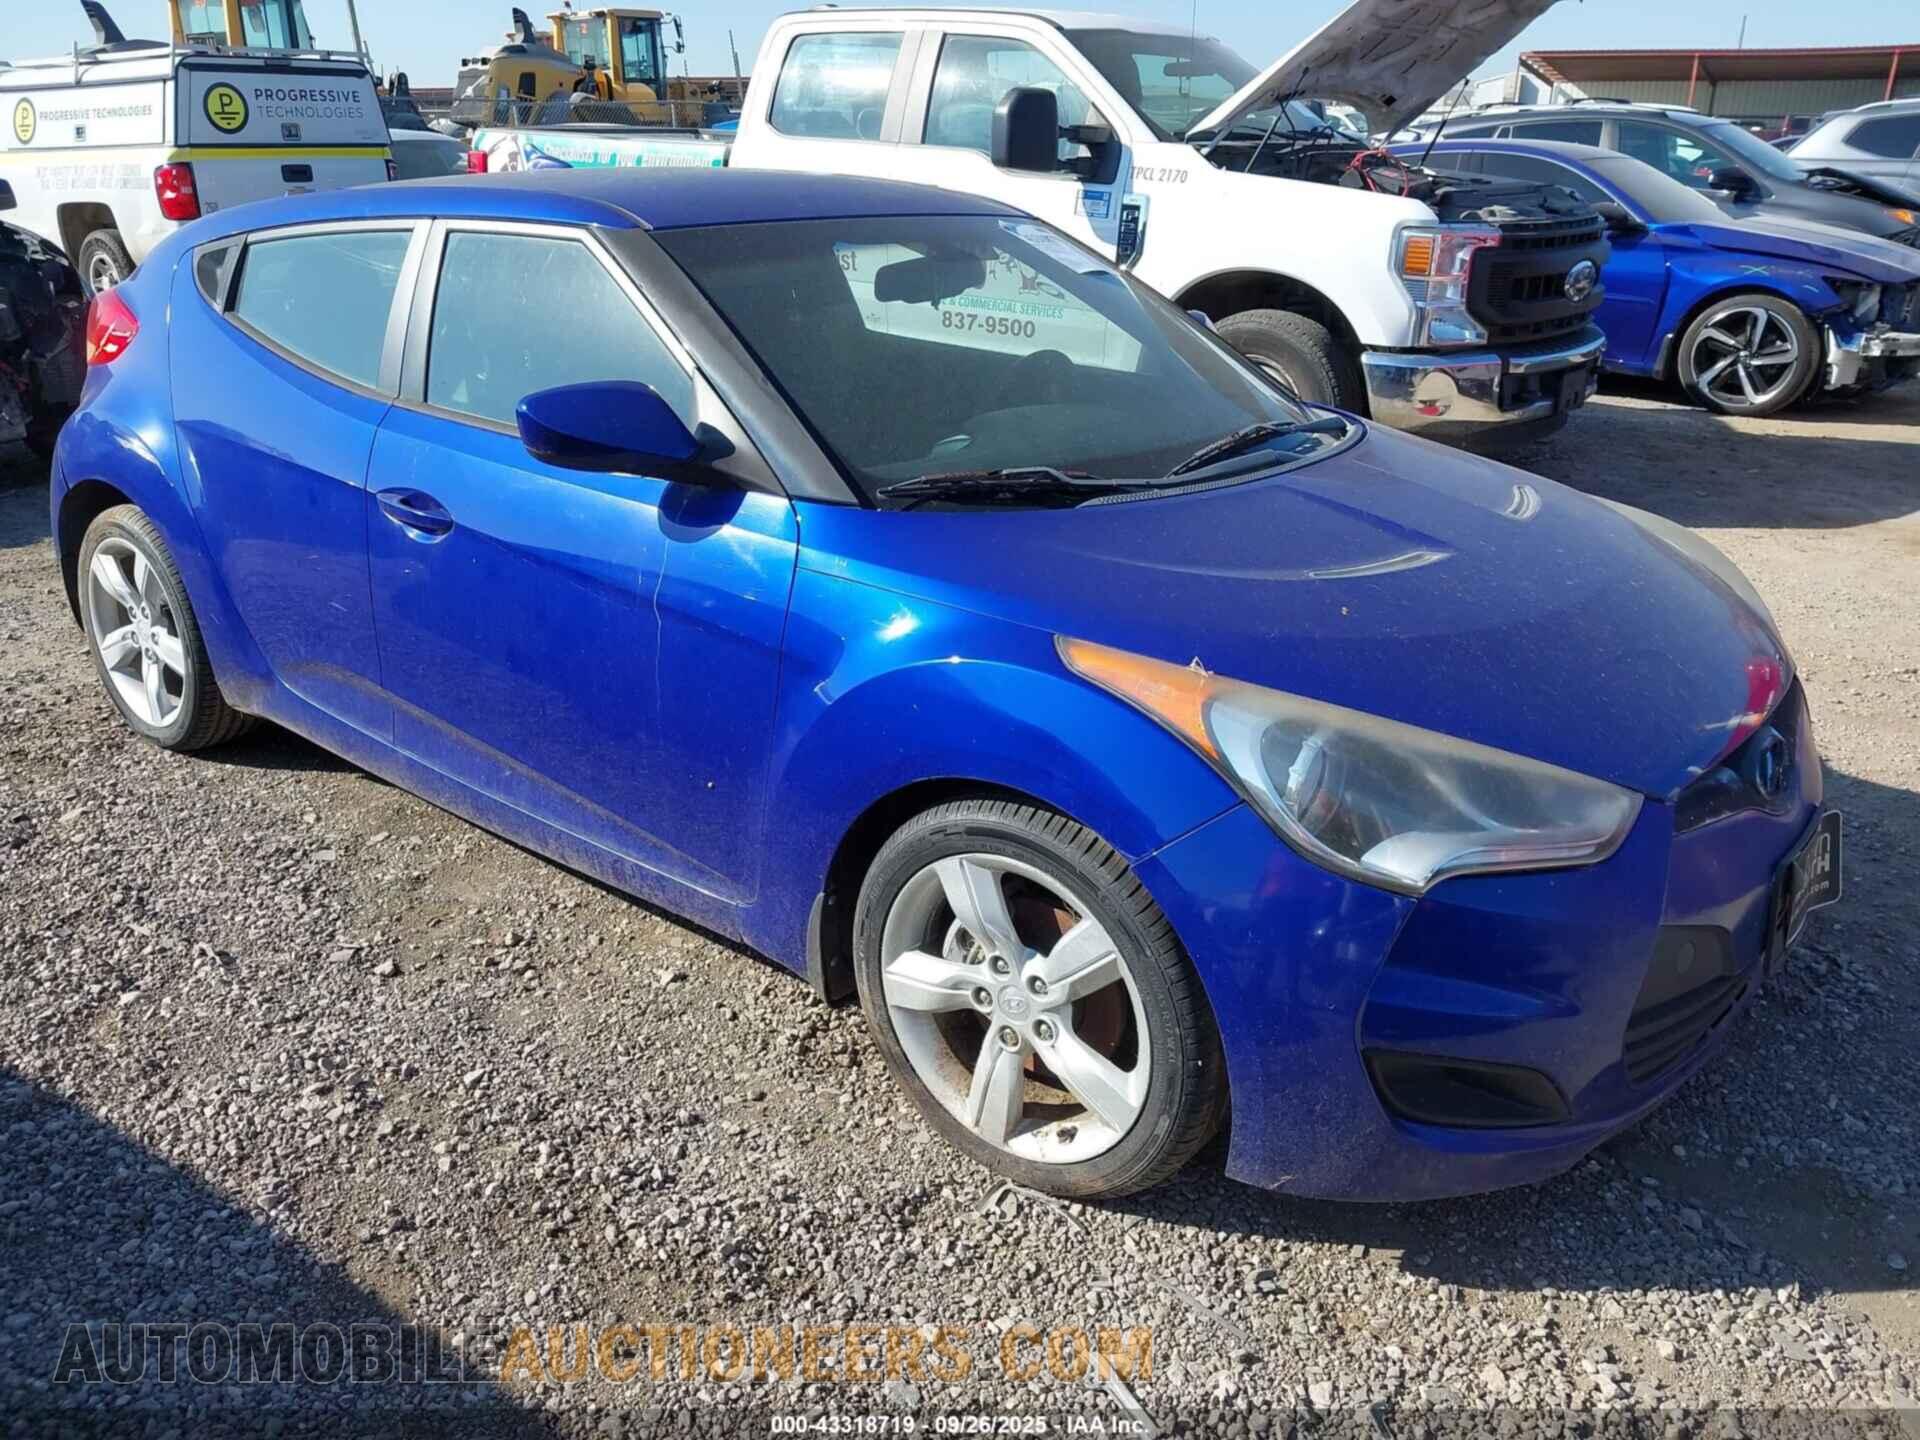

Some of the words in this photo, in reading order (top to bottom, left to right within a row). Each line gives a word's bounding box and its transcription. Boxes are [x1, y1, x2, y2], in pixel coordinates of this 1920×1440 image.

[254, 88, 361, 103] PROGRESSIVE
[39, 109, 90, 121] PROGRESSIVE
[92, 104, 153, 119] TECHNOLOGIES
[256, 105, 364, 119] TECHNOLOGIES
[1158, 168, 1189, 183] 2170
[958, 296, 1018, 313] COMMERCIAL
[1019, 304, 1064, 319] SERVICES
[941, 310, 1036, 339] 837-9500
